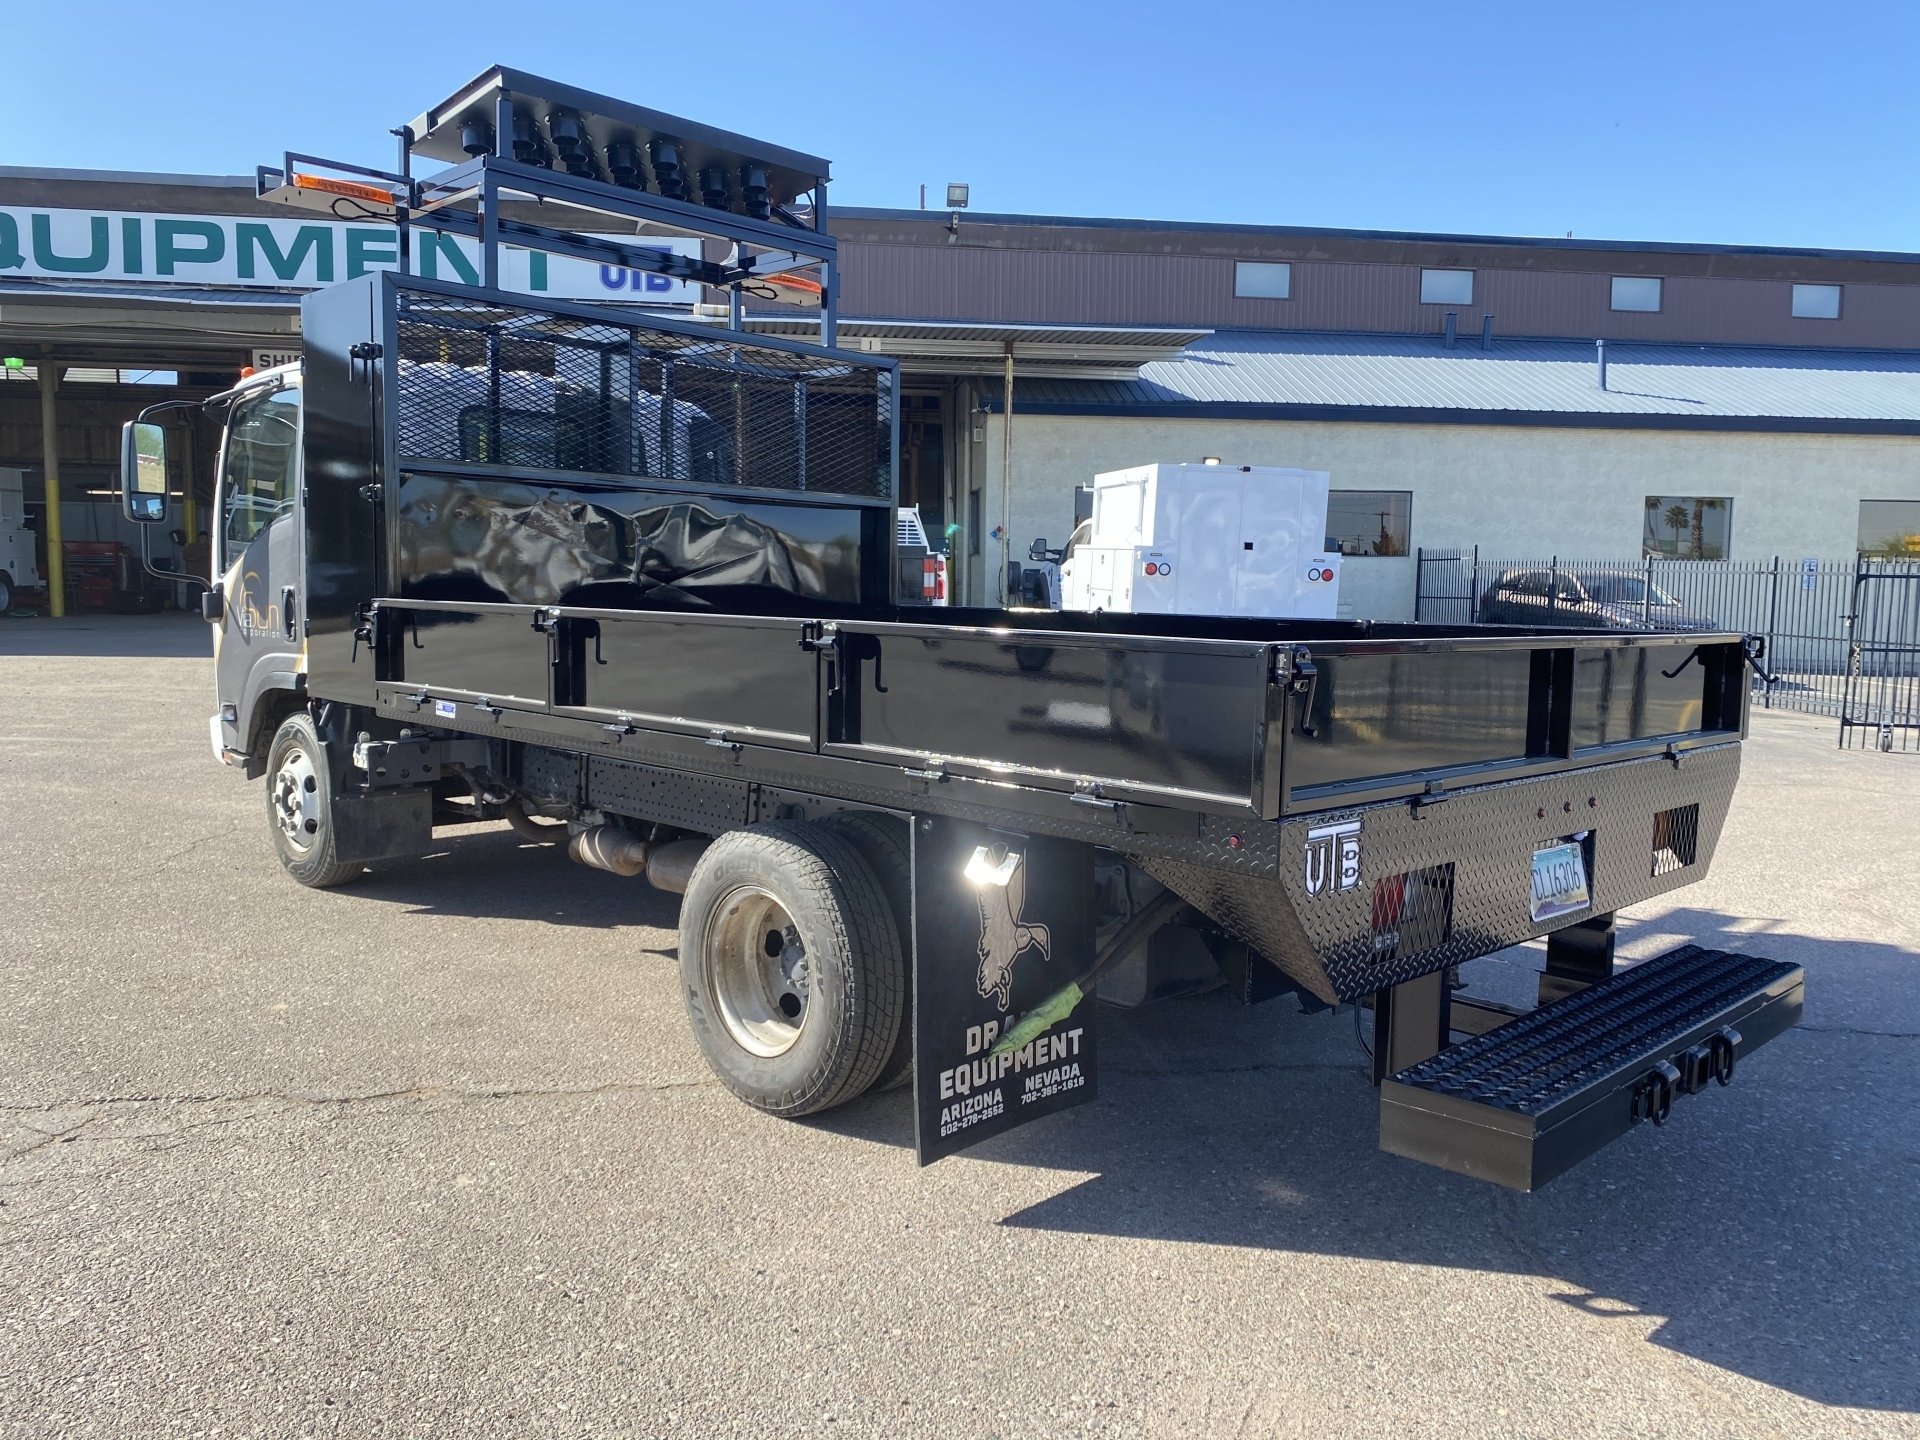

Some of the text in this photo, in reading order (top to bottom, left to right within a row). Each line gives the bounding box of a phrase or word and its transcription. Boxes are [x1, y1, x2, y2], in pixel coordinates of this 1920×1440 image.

[1304, 818, 1365, 898] UTB
[1531, 859, 1581, 902] CL16306
[939, 1027, 1084, 1101] EQUIPMENT
[1025, 1062, 1081, 1093] NEVADA
[940, 1087, 1004, 1126] ARIZONA
[940, 1103, 1004, 1137] 602-278-2552
